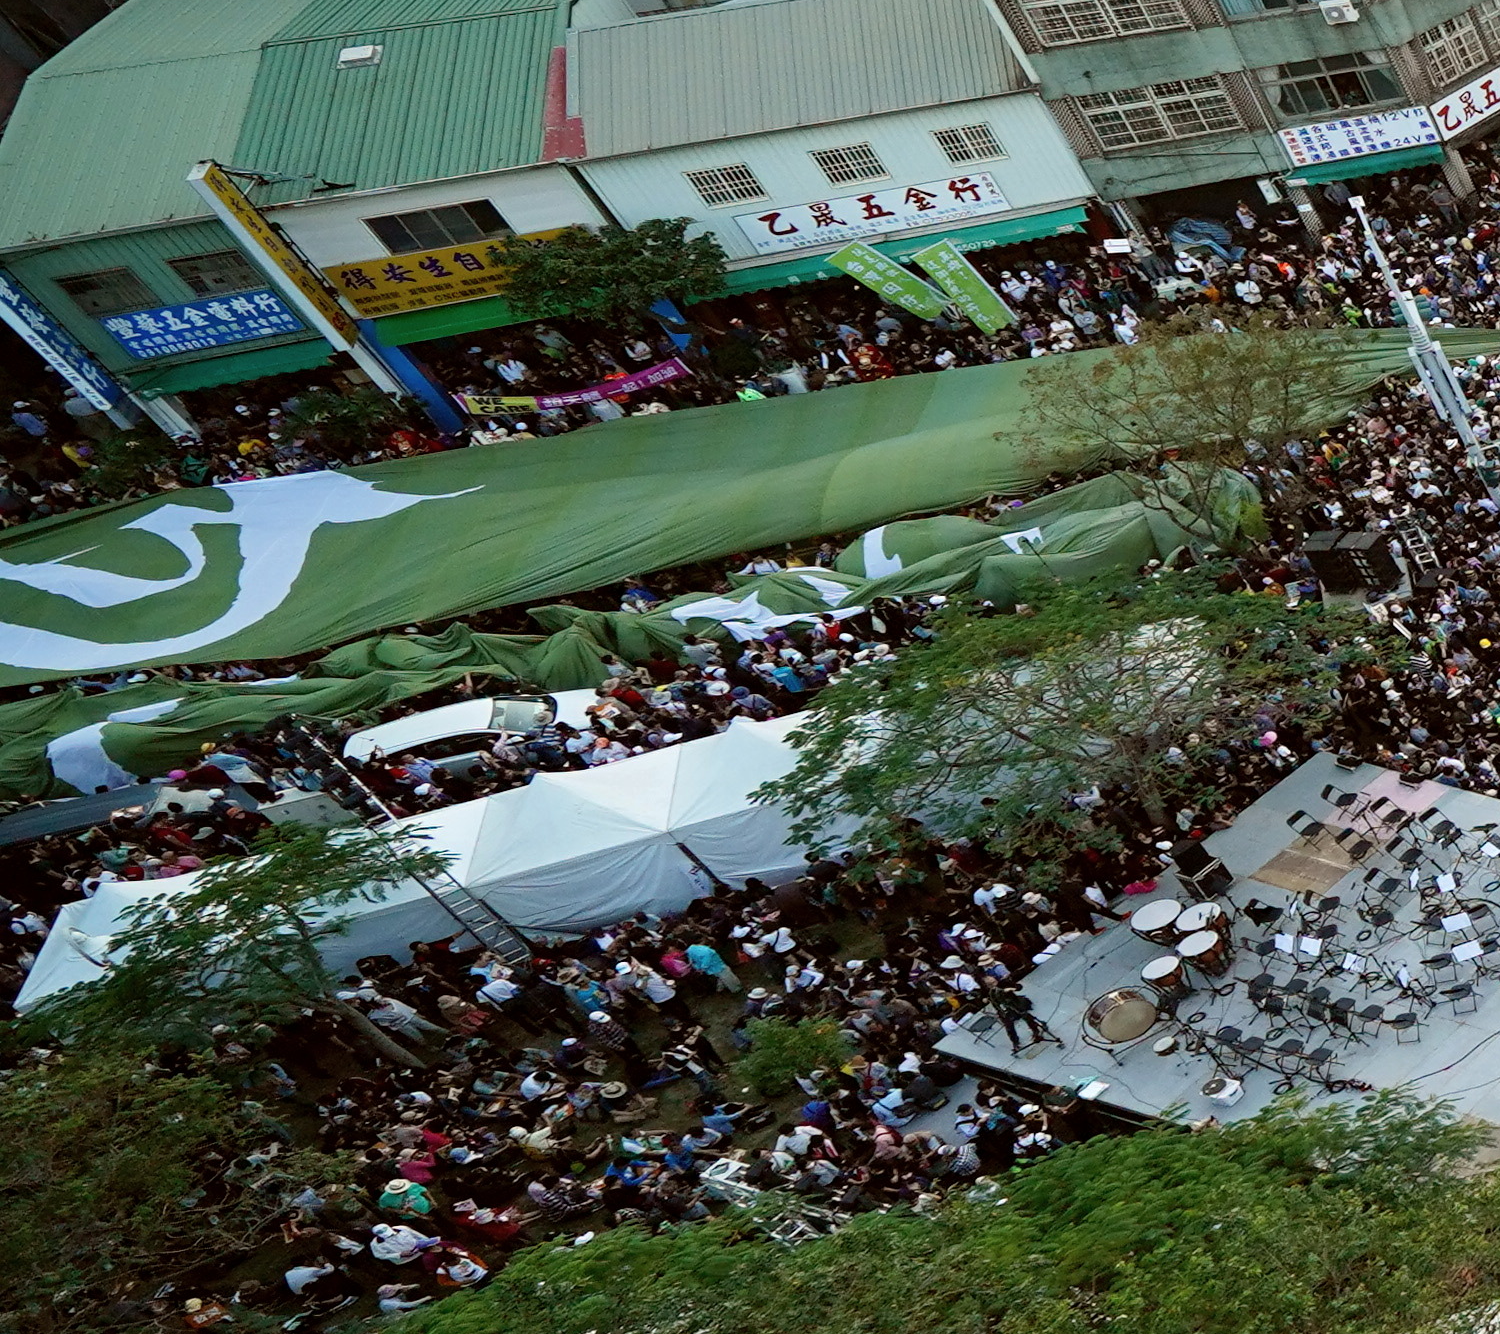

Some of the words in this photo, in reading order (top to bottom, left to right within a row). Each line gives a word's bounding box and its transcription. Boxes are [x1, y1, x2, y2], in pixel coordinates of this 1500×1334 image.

[1382, 110, 1410, 123] 12V
[1393, 135, 1422, 147] 24V
[758, 177, 980, 237] 乙晟五金行
[472, 396, 503, 406] WE
[480, 404, 533, 414] CARE
